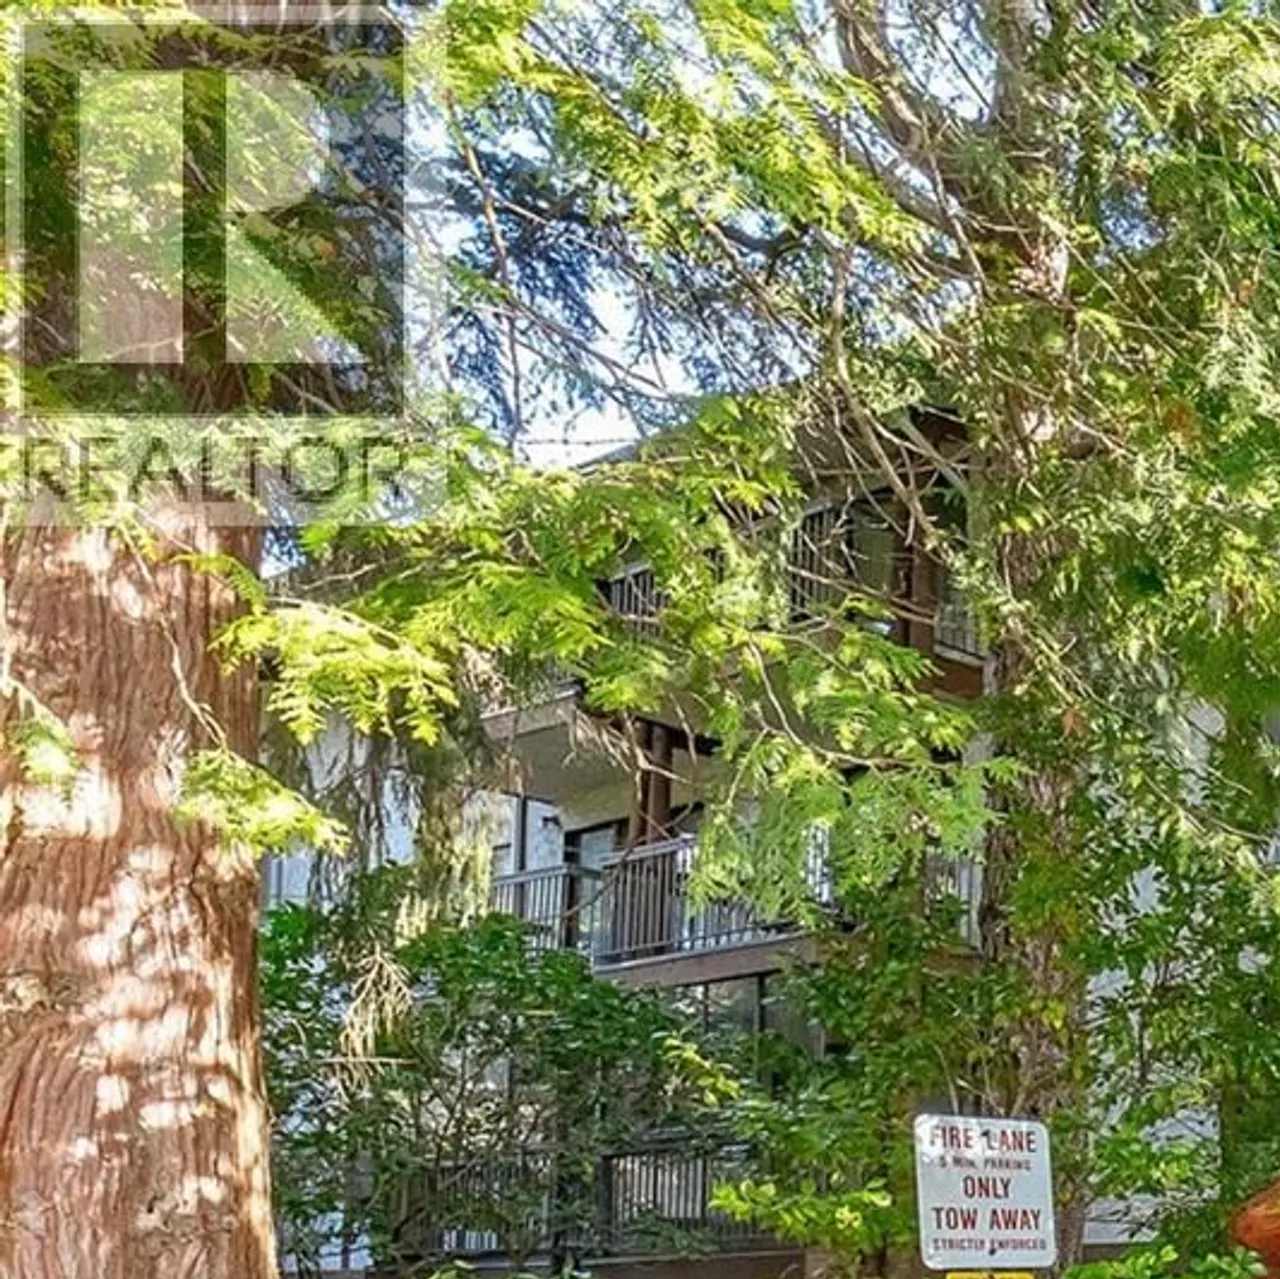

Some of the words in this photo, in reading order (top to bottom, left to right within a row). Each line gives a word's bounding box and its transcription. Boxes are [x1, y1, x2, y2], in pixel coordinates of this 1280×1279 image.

[930, 1125, 973, 1149] FIRE
[986, 1129, 1037, 1153] LANE
[963, 1175, 1013, 1199] ONLY
[932, 1206, 978, 1230] TOW
[989, 1207, 1042, 1231] AWAY
[933, 1237, 985, 1251] STRICTLY
[989, 1237, 1047, 1251] ENFORCED
